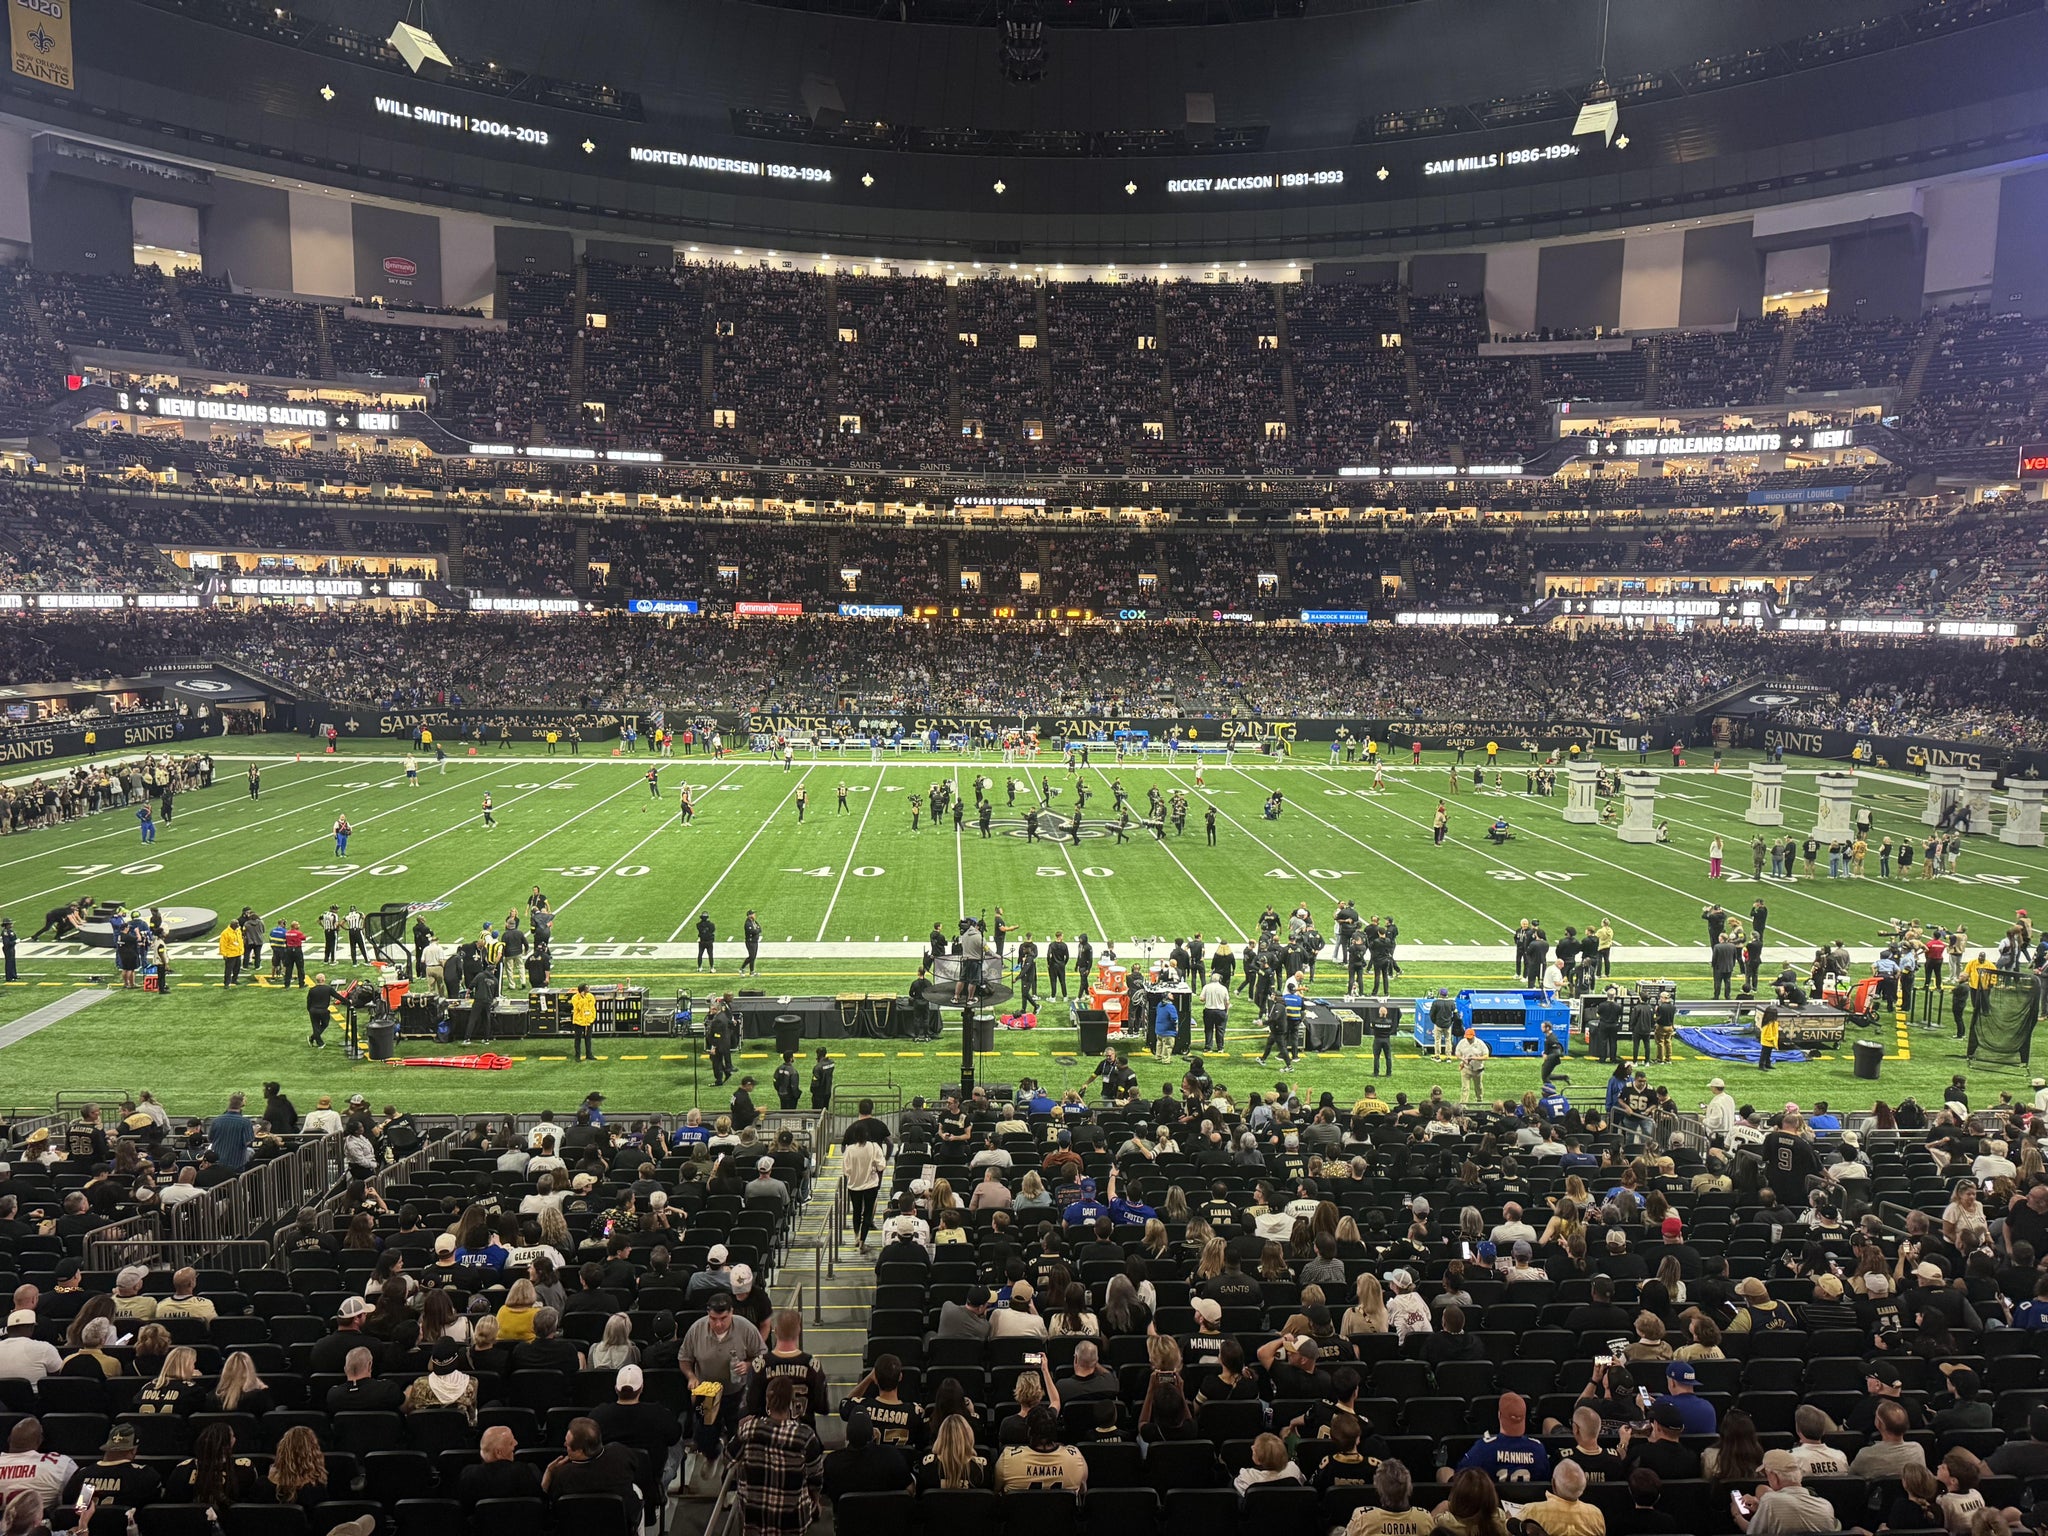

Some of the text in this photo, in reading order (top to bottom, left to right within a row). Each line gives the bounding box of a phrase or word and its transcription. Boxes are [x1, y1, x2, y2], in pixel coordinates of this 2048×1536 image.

[36, 58, 69, 73] ORLEANS
[16, 59, 70, 85] SAINTS
[375, 96, 549, 145] WILL SMITH 2004-2013
[630, 147, 832, 182] MORTEN ANDERSEN 1982-1994
[1424, 160, 1454, 175] SAM
[1457, 154, 1497, 171] MILLS
[1168, 170, 1344, 192] RICKEY JACKSON 1981-1993
[158, 398, 195, 416] NEW
[199, 402, 267, 423] ORLEANS
[270, 407, 327, 427] SAINTS
[359, 413, 391, 430] NEW
[1625, 431, 1844, 455] NEW ORLEANS SAINTS NEW
[118, 453, 152, 465] SAINTS
[707, 454, 740, 464] SAINTS
[780, 457, 811, 466] SAINTS
[194, 461, 228, 472] SAINTS
[850, 461, 881, 469] SAINTS
[920, 463, 950, 471] SAINTS
[1057, 466, 1088, 475] SAINTS
[1125, 466, 1157, 475] SAINTS
[1193, 466, 1225, 475] SAINTS
[1263, 466, 1294, 475] SAINTS
[270, 467, 304, 477] SAINTS
[347, 472, 381, 482] SAINTS
[1807, 490, 1834, 499] LOUNGE
[997, 497, 1046, 506] SUPERDOME
[231, 579, 413, 596] NEW ORLEANS SAINTS NEW
[469, 598, 579, 612] NEW ORLEANS SAINTS
[700, 603, 732, 611] SAINTS
[739, 604, 778, 614] Community
[1593, 600, 1720, 614] NEW ORLEANS SAINTS
[850, 605, 900, 617] Ochsner
[1119, 609, 1146, 619] COX
[1166, 610, 1196, 618] SAINTS
[1222, 613, 1253, 621] entergy
[1396, 613, 1416, 624] NEW
[1461, 613, 1499, 625] SAINTS
[749, 716, 827, 733] SAINTS
[1055, 719, 1131, 740] SAINTS
[125, 724, 174, 745] SAINTS
[1765, 728, 1823, 753] SAINTS
[0, 738, 54, 762] SAINTS
[1906, 745, 1982, 770] SAINTS
[310, 864, 408, 876] 20
[560, 865, 651, 877] 30
[803, 866, 886, 877] 40
[1035, 866, 1114, 877] 50
[1263, 868, 1342, 879] 40
[1485, 870, 1573, 881] 30
[1802, 1030, 1842, 1041] SAINTS
[1629, 1094, 1648, 1111] 56
[682, 1132, 702, 1141] TAYLOR
[1739, 1128, 1761, 1139] GLEASON
[69, 1135, 94, 1156] 26
[1777, 1147, 1793, 1171] 9
[1082, 1207, 1097, 1216] DART
[461, 1254, 487, 1264] TAYLOR
[515, 1250, 545, 1261] GLEASON
[1220, 1285, 1249, 1293] SAINTS
[114, 1310, 133, 1318] MARA
[1318, 1345, 1341, 1358] REES
[1496, 1450, 1535, 1464] MANNING
[1026, 1466, 1064, 1476] KAMARA
[1811, 1462, 1838, 1474] BREES
[1381, 1522, 1417, 1536] JORDAN
